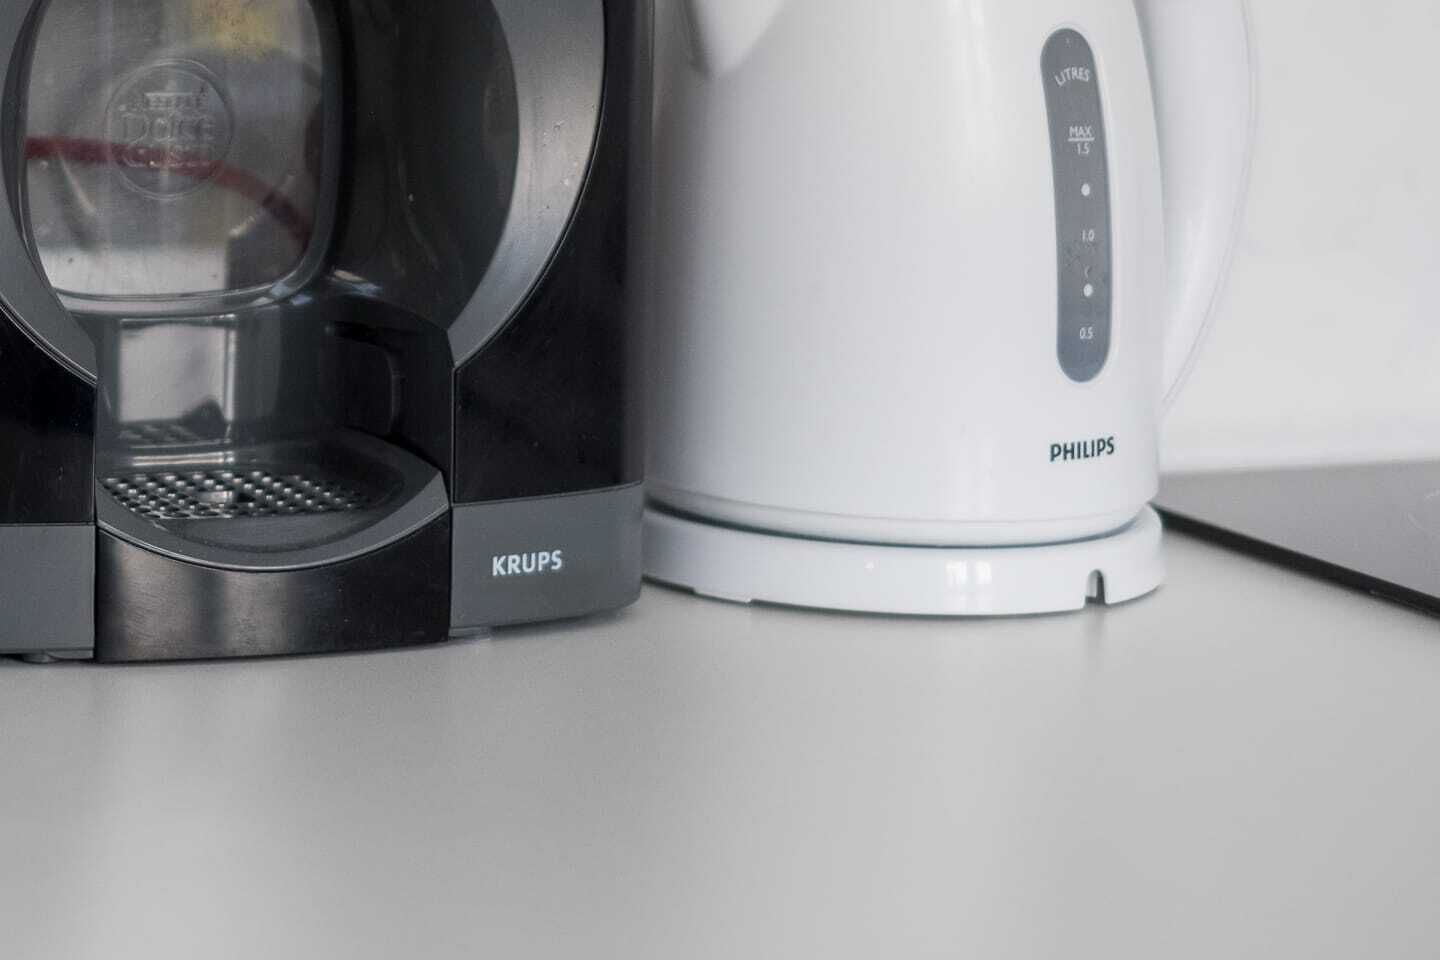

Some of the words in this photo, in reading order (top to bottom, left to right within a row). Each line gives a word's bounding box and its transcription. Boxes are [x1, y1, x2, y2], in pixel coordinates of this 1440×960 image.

[1054, 67, 1091, 87] LITRES
[1069, 125, 1093, 138] MAX
[1081, 229, 1096, 242] 1.0
[1079, 327, 1094, 340] 0.5
[1049, 435, 1116, 462] PHILIPS
[491, 549, 563, 577] KRUPS
